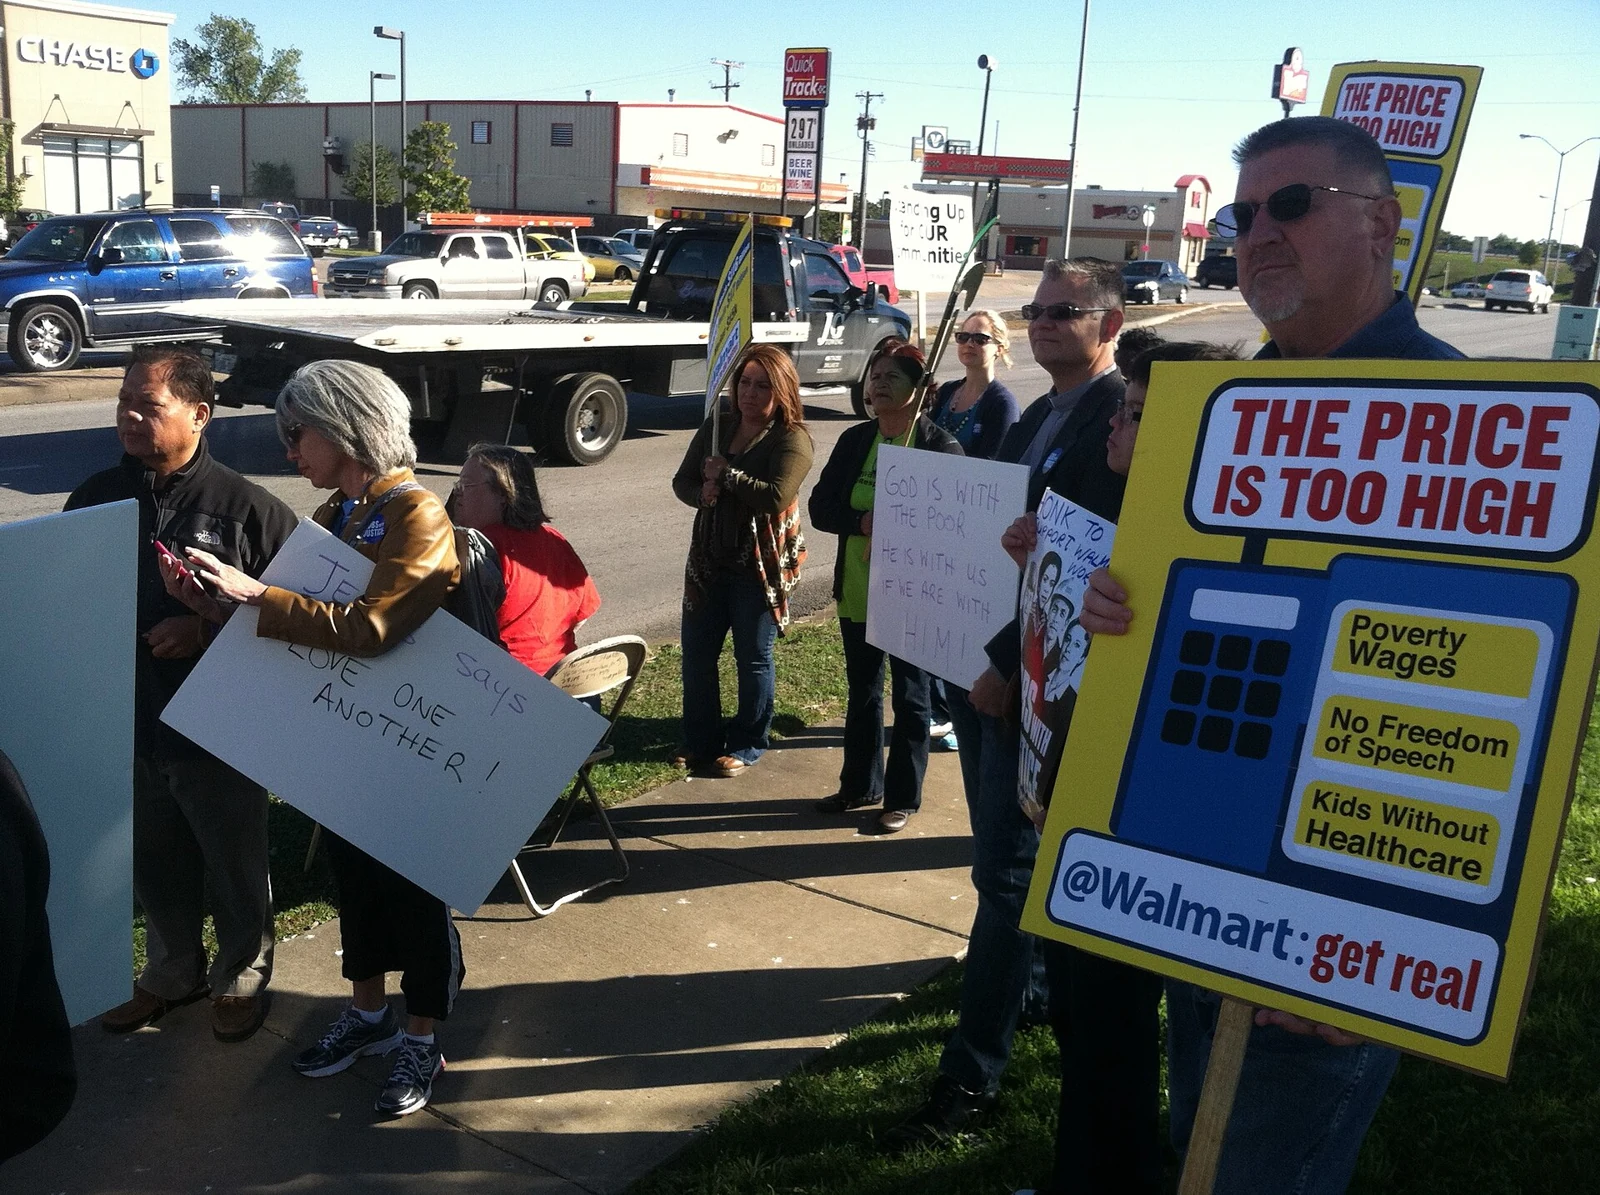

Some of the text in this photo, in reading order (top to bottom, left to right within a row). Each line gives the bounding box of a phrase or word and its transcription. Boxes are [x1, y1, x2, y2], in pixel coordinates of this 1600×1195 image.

[17, 35, 126, 73] CHASE
[785, 55, 815, 73] Quick
[784, 76, 819, 97] Track
[1342, 82, 1452, 118] THE PRICE
[1383, 118, 1442, 149] HIGH
[789, 159, 812, 168] BEER
[789, 168, 812, 178] WINE
[973, 161, 999, 172] Track
[946, 203, 965, 223] Up
[1232, 398, 1571, 471] THE PRICE
[885, 465, 918, 498] GOD
[926, 477, 943, 502] IS
[955, 479, 1000, 515] WITH
[1212, 465, 1556, 539] IS TOO HIGH
[890, 504, 966, 539] THE POOR
[1036, 524, 1076, 552] UPPORT
[1040, 495, 1104, 541] ONK TO
[881, 538, 988, 587] HE IS WITH US
[881, 578, 991, 625] IF WE ARE WITH
[1349, 613, 1467, 656] Poverty
[1348, 638, 1458, 681] Wages
[287, 643, 457, 727] LOVE ONE
[312, 682, 466, 784] ANOTHER
[1324, 734, 1456, 774] of Speech
[1330, 707, 1509, 758] No Freedom
[1311, 788, 1490, 846] Kids Without
[1304, 818, 1483, 881] Healthcare
[1308, 931, 1386, 984] get
[1388, 954, 1484, 1013] real
